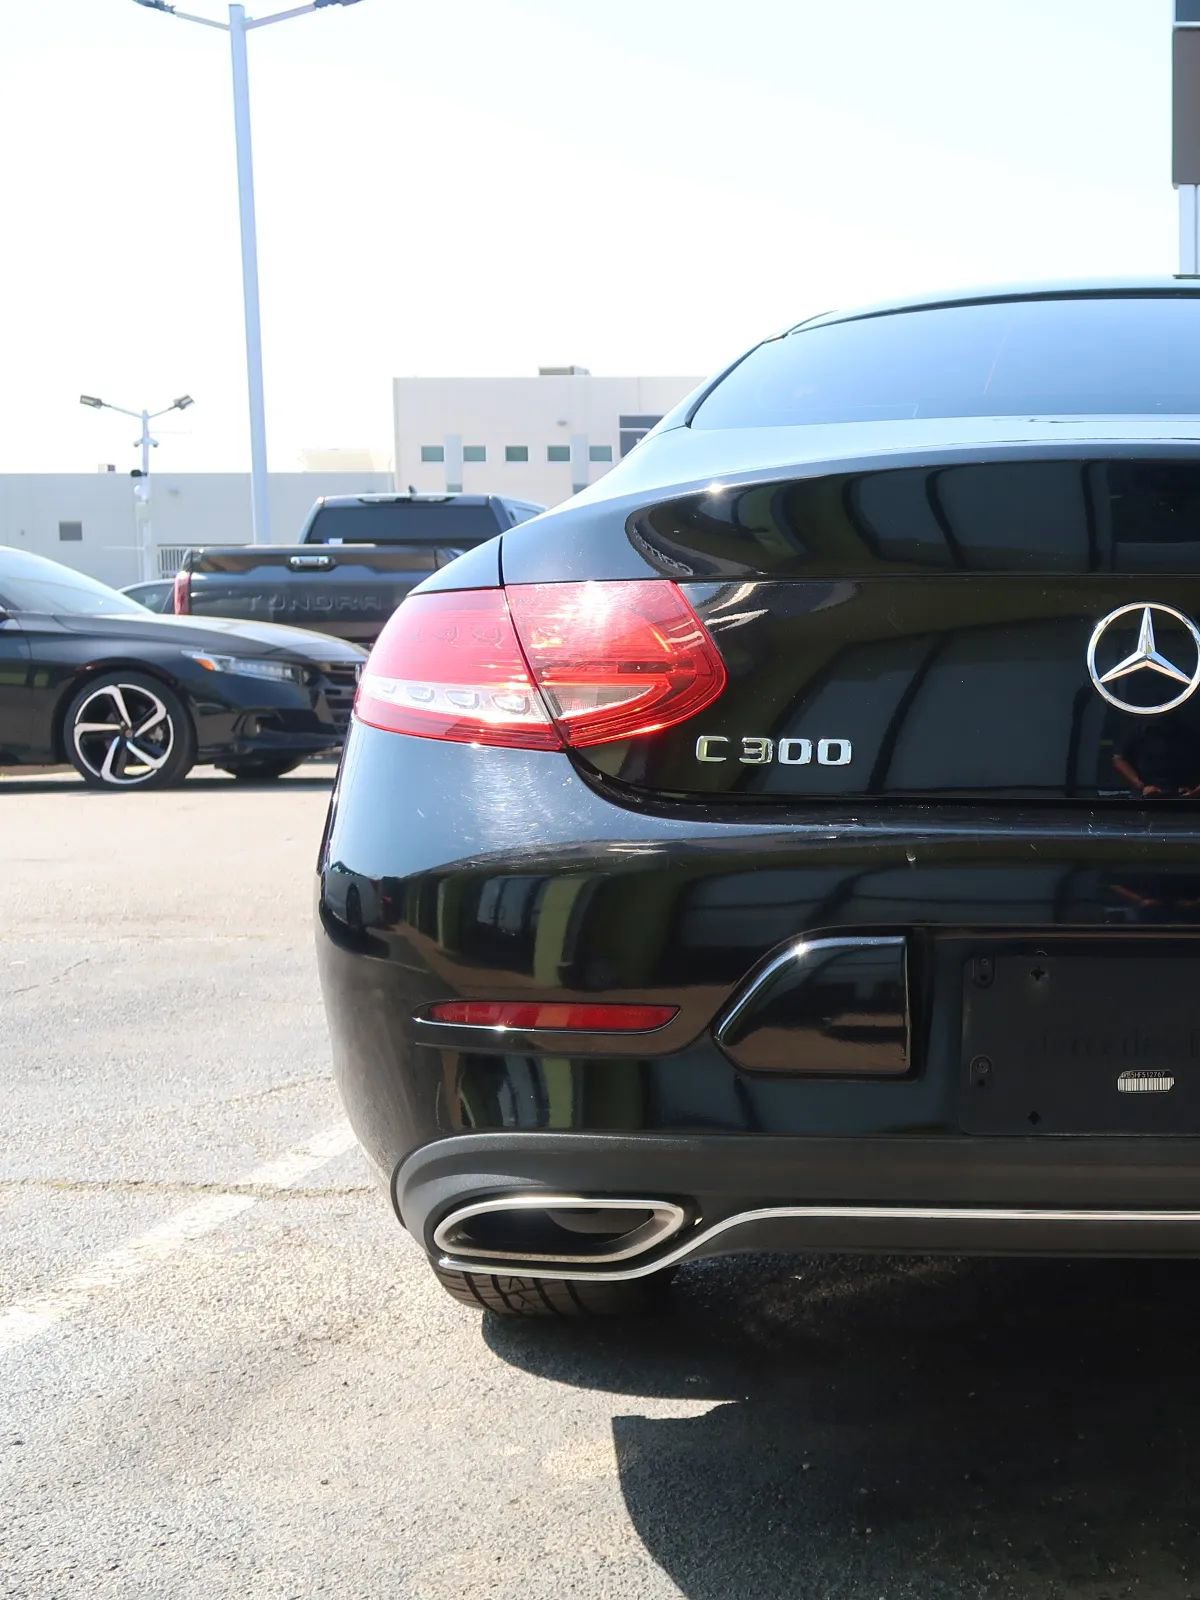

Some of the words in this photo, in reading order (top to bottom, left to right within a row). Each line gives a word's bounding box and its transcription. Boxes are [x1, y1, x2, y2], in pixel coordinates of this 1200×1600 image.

[246, 591, 382, 612] TUNDRA
[695, 735, 729, 763] C
[738, 736, 853, 766] 300
